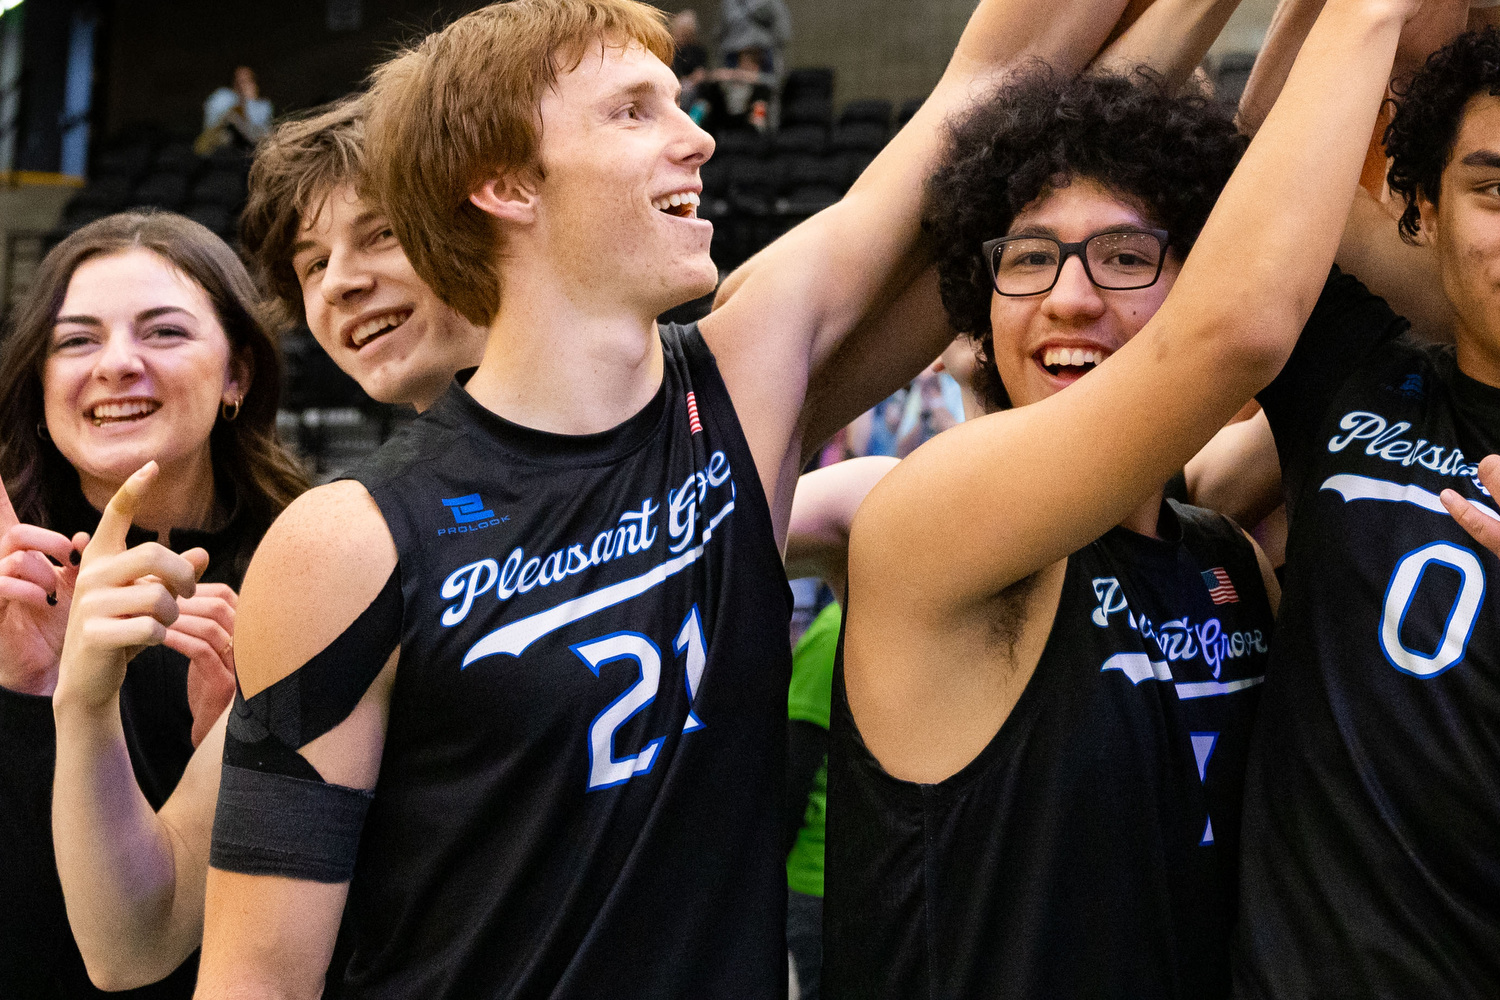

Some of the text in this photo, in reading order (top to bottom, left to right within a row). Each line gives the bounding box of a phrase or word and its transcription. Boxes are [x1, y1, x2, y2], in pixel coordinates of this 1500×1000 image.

[437, 515, 511, 537] PROLOOK
[440, 497, 660, 627] Pleasant
[1378, 540, 1486, 679] 0
[569, 602, 708, 793] 21
